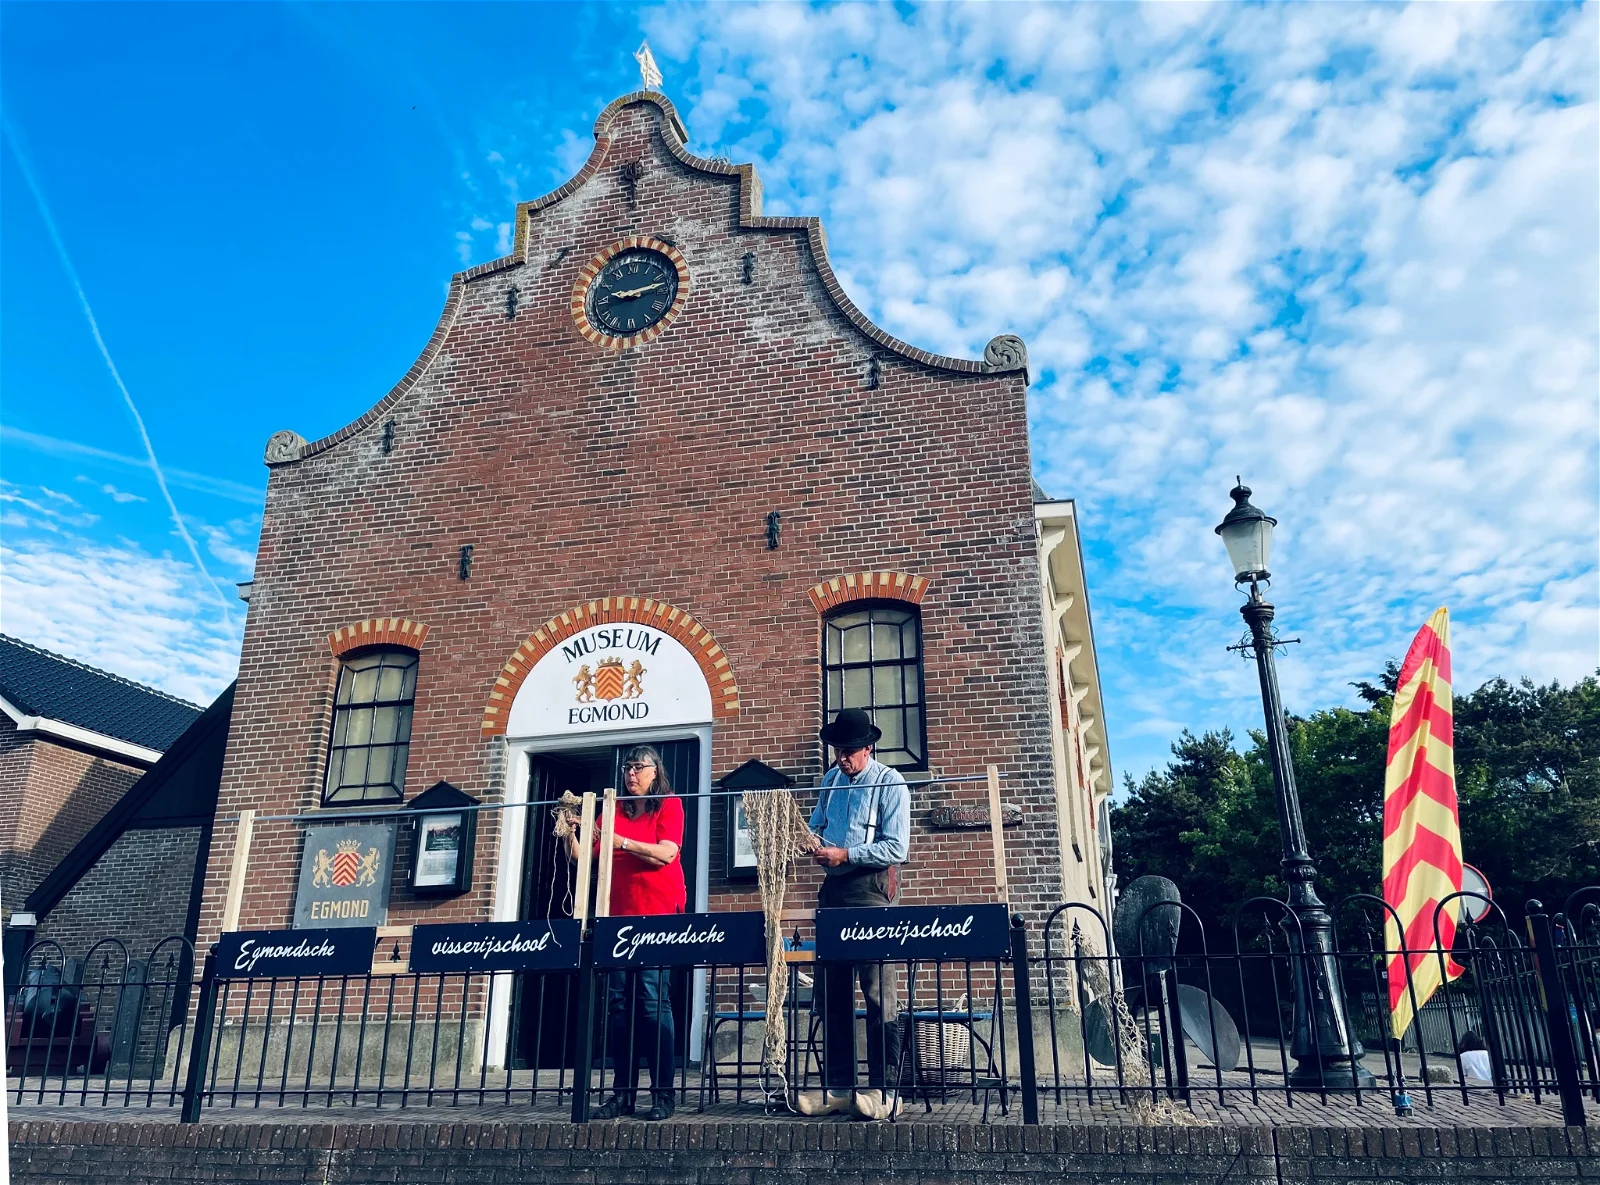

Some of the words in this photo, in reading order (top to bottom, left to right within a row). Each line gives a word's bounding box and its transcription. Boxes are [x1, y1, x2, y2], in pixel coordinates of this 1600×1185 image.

[562, 628, 663, 664] MUSEUM
[568, 702, 649, 724] EGMOND
[311, 900, 369, 919] EGMOND
[612, 924, 726, 959] Egmondsche
[840, 915, 974, 945] visserijschool
[234, 939, 336, 971] Egmondsche
[431, 932, 551, 961] visserijschool
